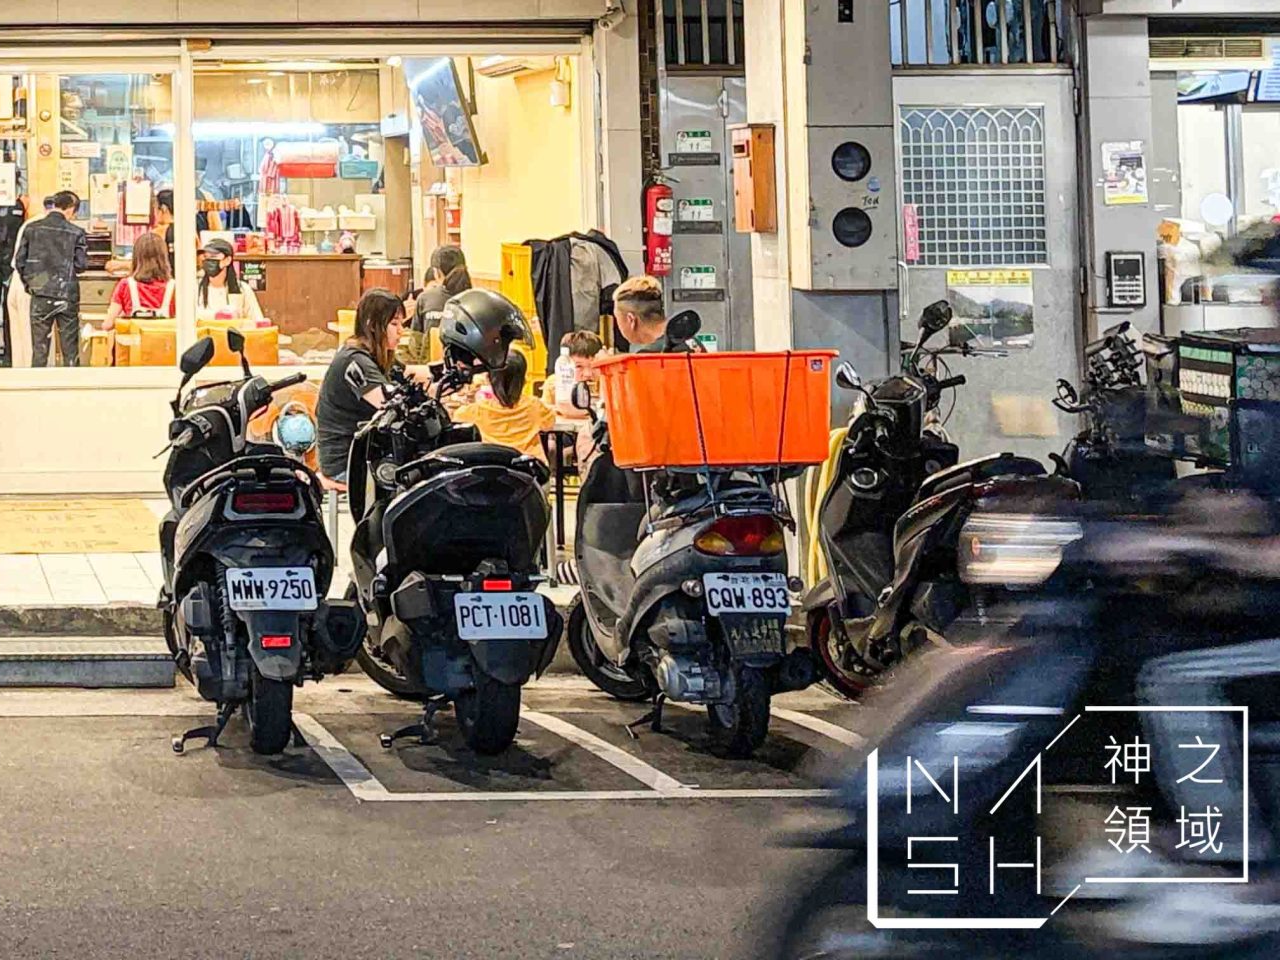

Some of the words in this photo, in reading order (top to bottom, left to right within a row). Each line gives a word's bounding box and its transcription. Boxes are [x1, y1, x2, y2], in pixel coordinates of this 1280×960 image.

[232, 579, 312, 600] MWW-9250
[708, 587, 789, 609] CQW-893
[459, 604, 540, 628] PCT-1081
